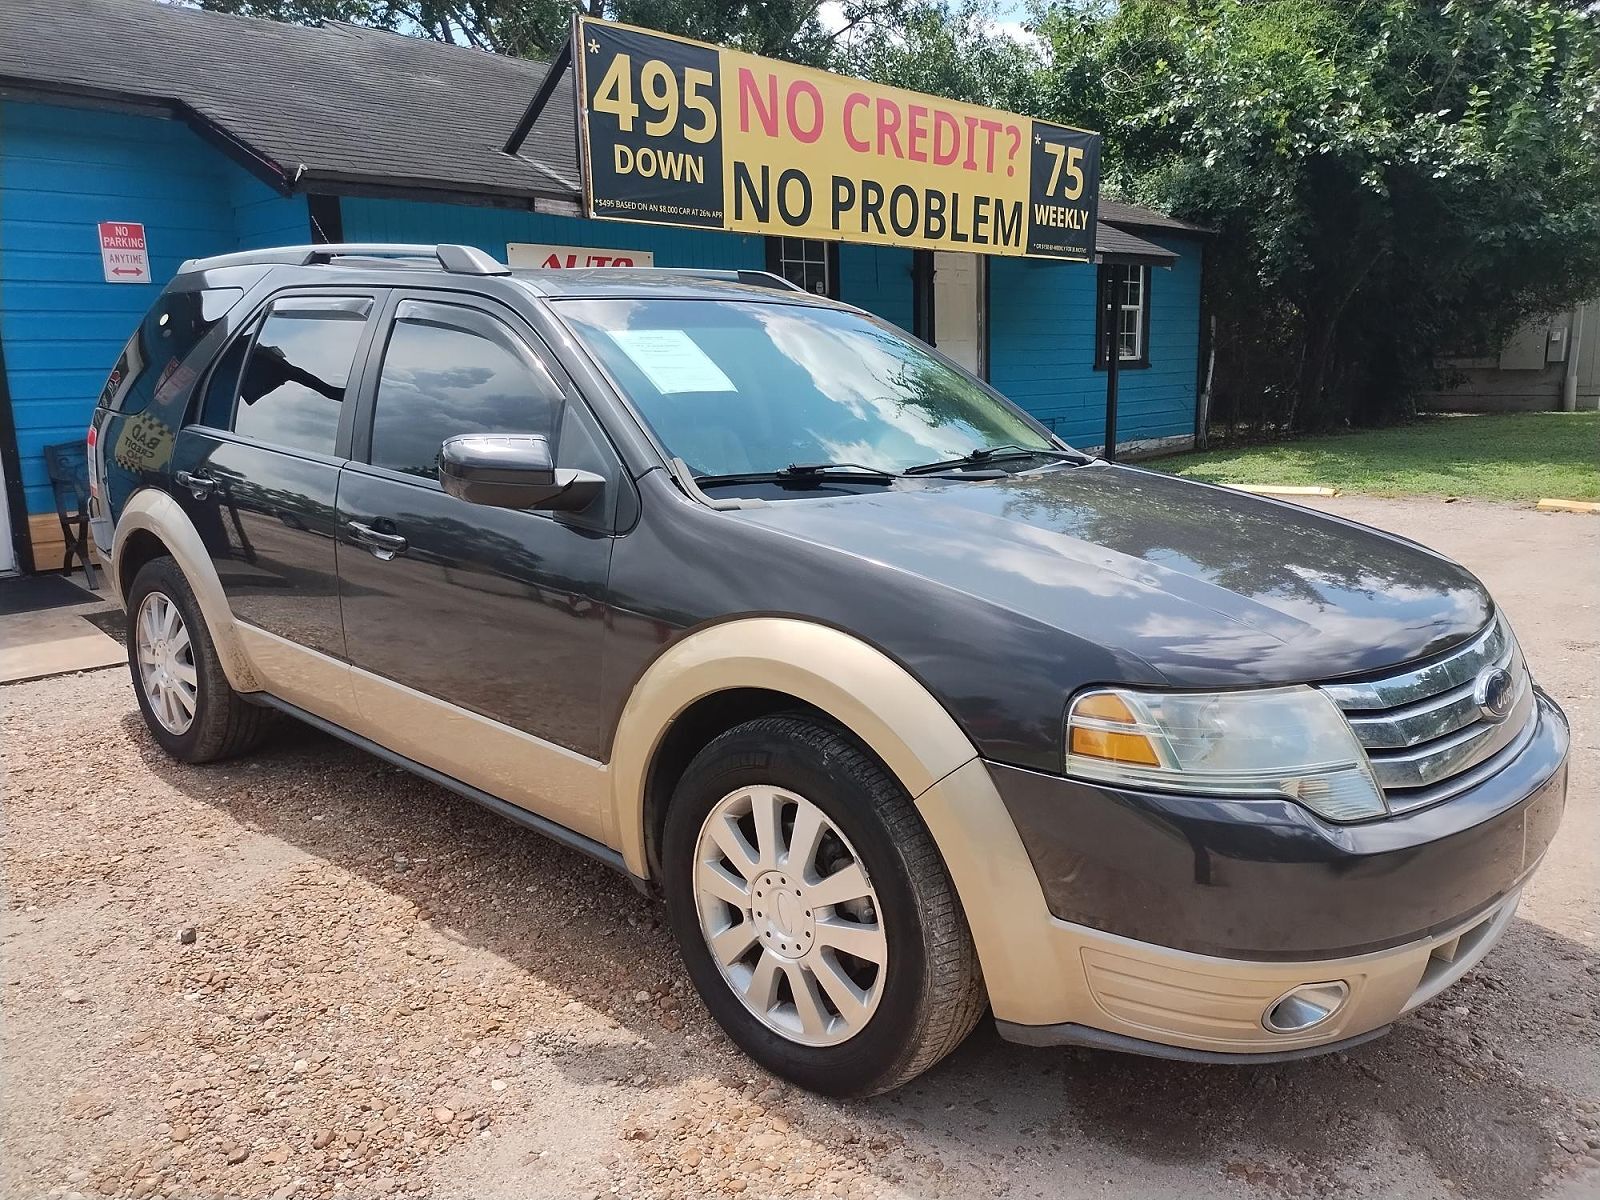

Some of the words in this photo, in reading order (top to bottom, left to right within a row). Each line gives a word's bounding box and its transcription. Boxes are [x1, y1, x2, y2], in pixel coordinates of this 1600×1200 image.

[738, 67, 824, 144] NO
[843, 92, 1022, 177] CREDIT?
[614, 143, 704, 184] DOWN
[615, 200, 636, 210] BASED
[637, 202, 648, 211] ON
[649, 203, 658, 212] AN
[679, 207, 691, 215] CAR
[691, 208, 699, 216] AT
[712, 210, 723, 218] APR
[734, 161, 813, 227] NO
[831, 175, 1023, 247] PROBLEM
[1034, 204, 1089, 230] WEEKLY
[103, 236, 144, 248] PARKING
[115, 226, 128, 236] NO
[110, 254, 143, 264] ANYTIME
